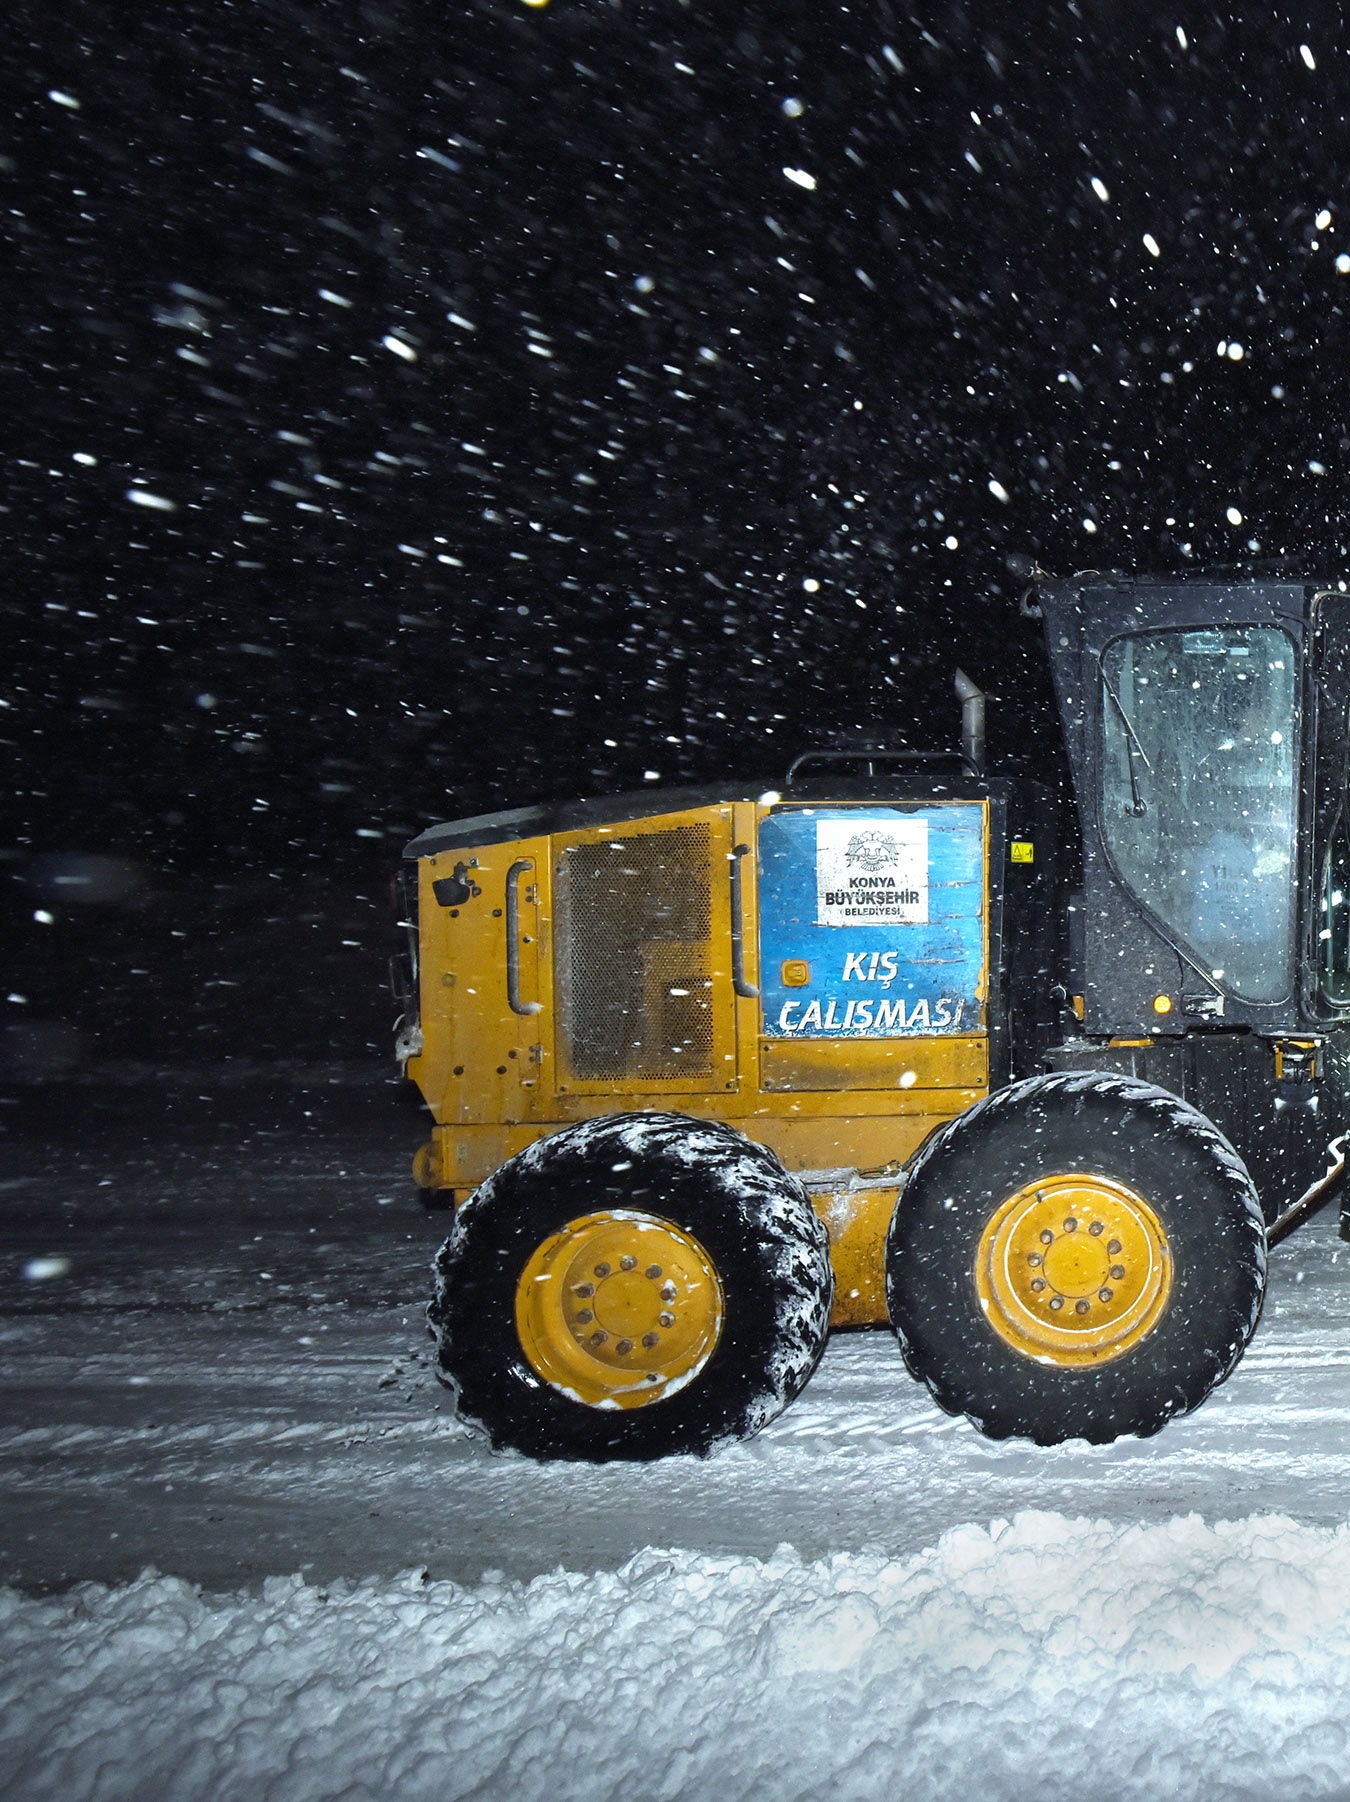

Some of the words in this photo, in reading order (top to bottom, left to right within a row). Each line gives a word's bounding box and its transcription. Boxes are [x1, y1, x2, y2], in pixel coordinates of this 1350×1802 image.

[849, 877, 896, 888] KONYA
[825, 888, 920, 906] BÜYÜKŞEHİR
[842, 951, 899, 990] KIŞ
[778, 998, 967, 1036] ÇALIŞMASI
